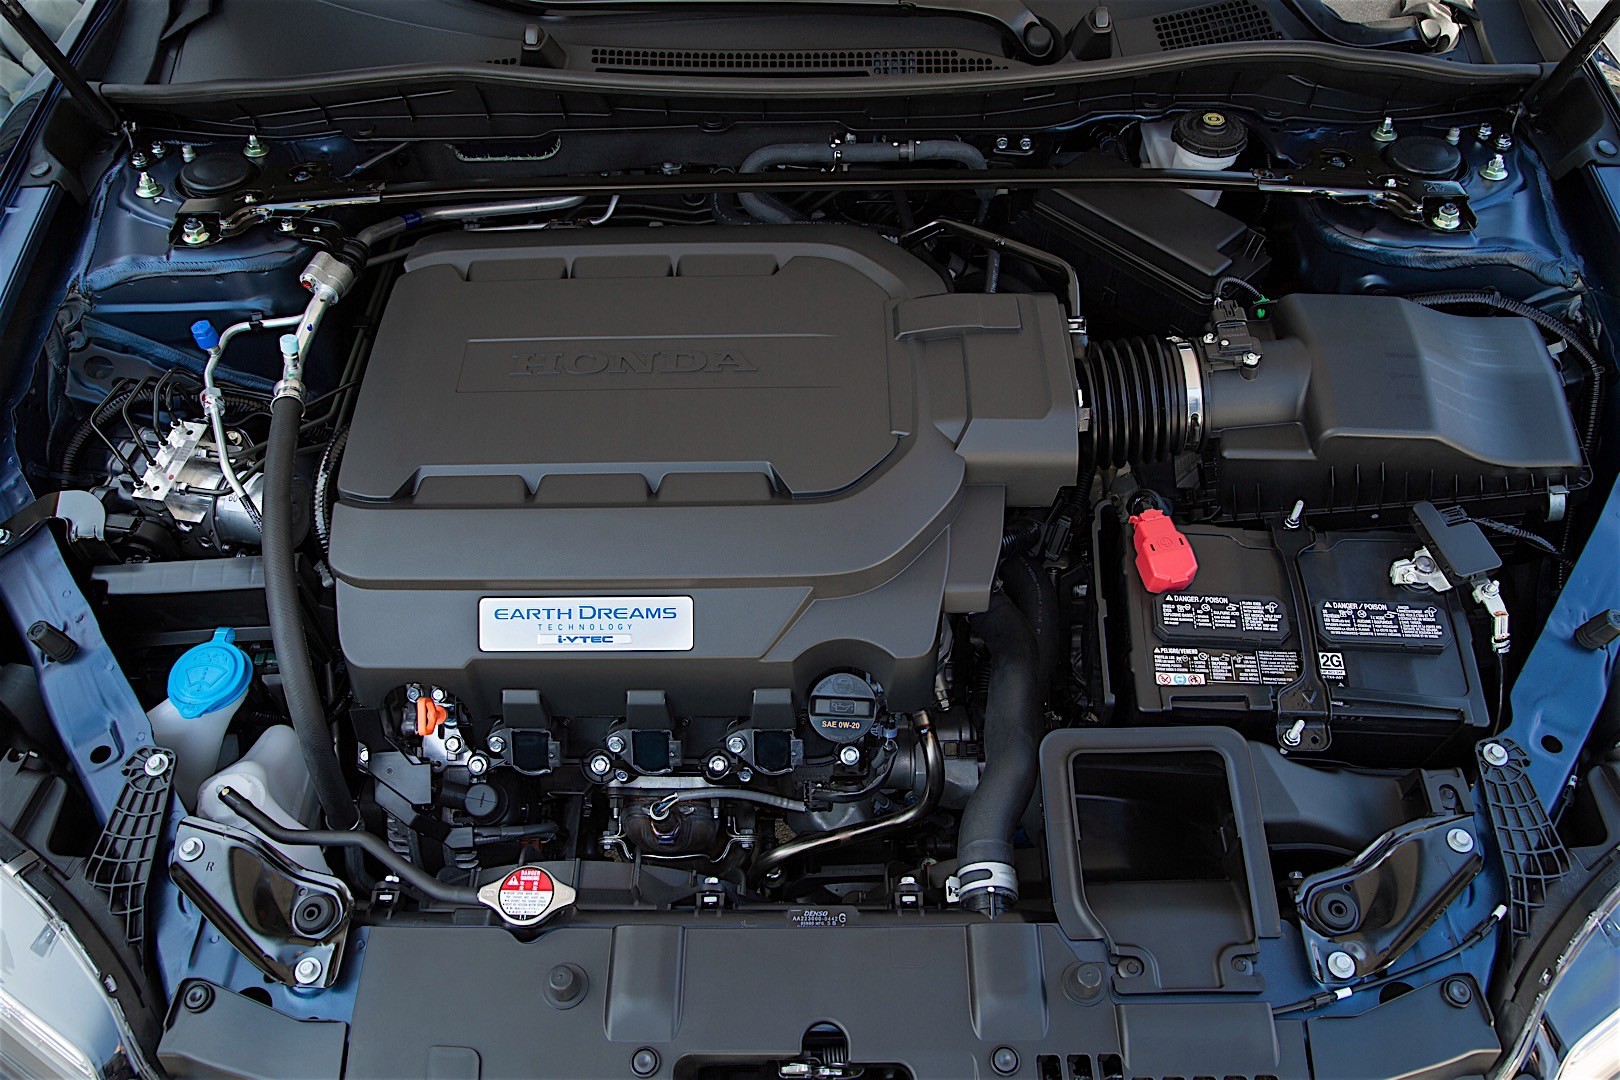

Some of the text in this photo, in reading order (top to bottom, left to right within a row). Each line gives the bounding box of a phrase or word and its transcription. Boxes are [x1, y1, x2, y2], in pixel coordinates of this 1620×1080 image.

[509, 350, 759, 375] HONDA
[1173, 595, 1199, 603] DANGER
[1332, 602, 1358, 610] DANGER
[494, 605, 677, 620] EARTH DREAMS
[538, 623, 633, 631] TECHNOLOGY
[557, 635, 614, 644] i-VTEC
[1321, 653, 1342, 668] 2G
[822, 720, 860, 729] SAE 0W-20
[205, 861, 215, 872] R
[838, 912, 847, 924] G
